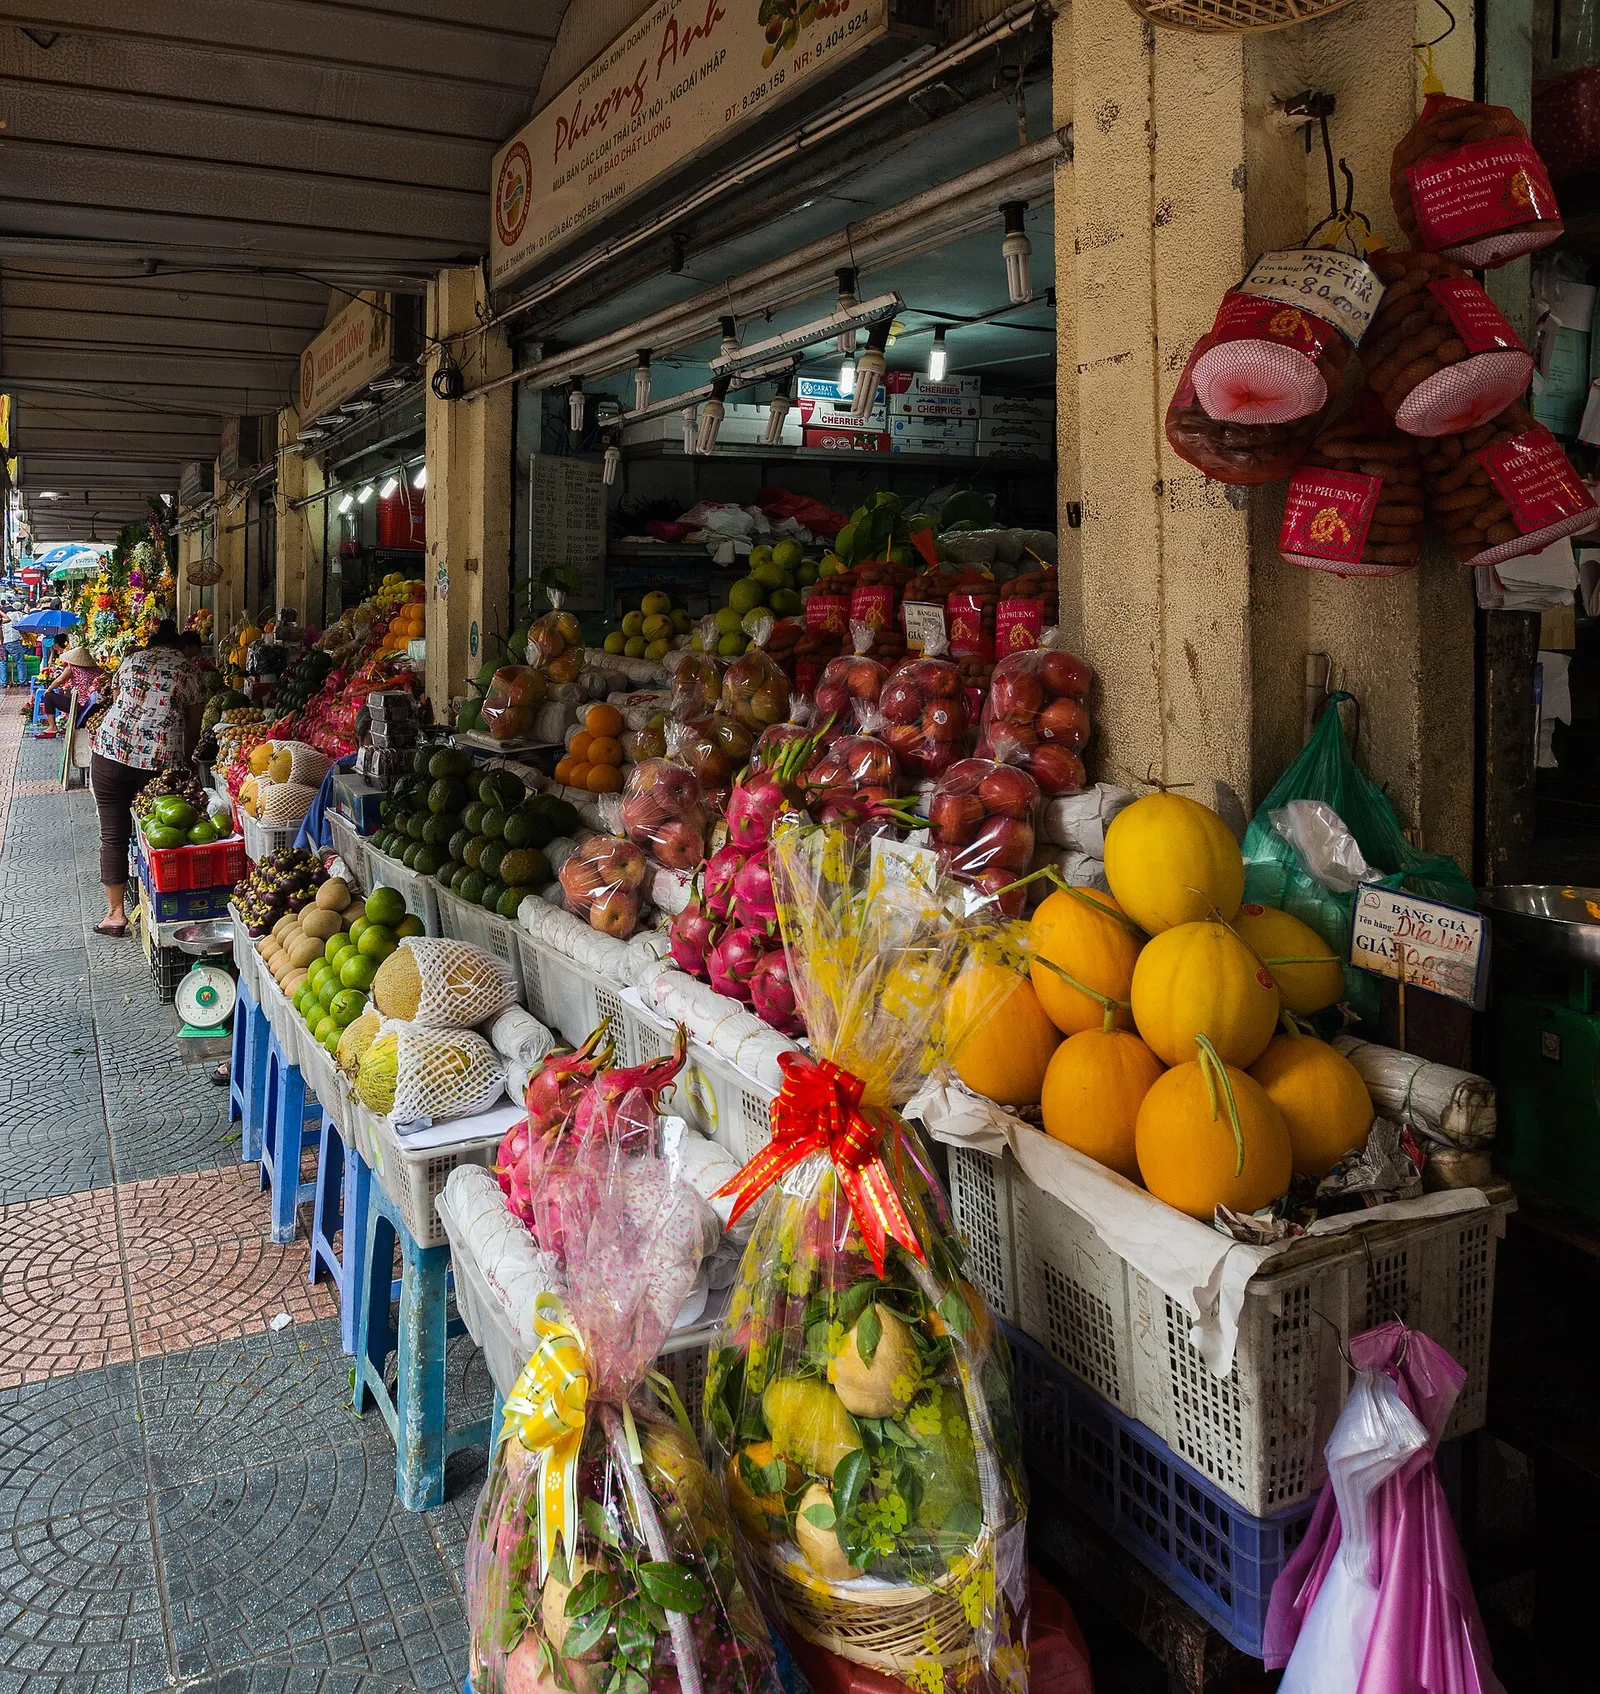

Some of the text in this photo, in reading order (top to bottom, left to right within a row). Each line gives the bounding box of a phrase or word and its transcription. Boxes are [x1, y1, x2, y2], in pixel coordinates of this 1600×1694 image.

[627, 25, 651, 51] DOANH
[700, 49, 727, 81] NHẬP
[742, 69, 785, 110] 8.299.158
[793, 51, 813, 74] NR:
[816, 8, 869, 58] 9.404.924
[554, 0, 726, 165] Phượng Anh
[1421, 168, 1453, 189] PHET
[1456, 158, 1490, 176] NAM
[1424, 171, 1505, 203] SWEET TAMARIND
[1250, 274, 1297, 288] GIÁ:
[813, 384, 833, 392] CARAT
[920, 385, 960, 395] CHERRIES
[821, 416, 864, 426] CHERRIES
[917, 405, 962, 415] CHERRIES
[1313, 485, 1362, 503] PHUENG
[1359, 915, 1372, 925] Tên
[1374, 919, 1395, 932] hàng:
[1392, 904, 1467, 933] BẢNG GIÁ
[1356, 934, 1393, 958] GIÁ:
